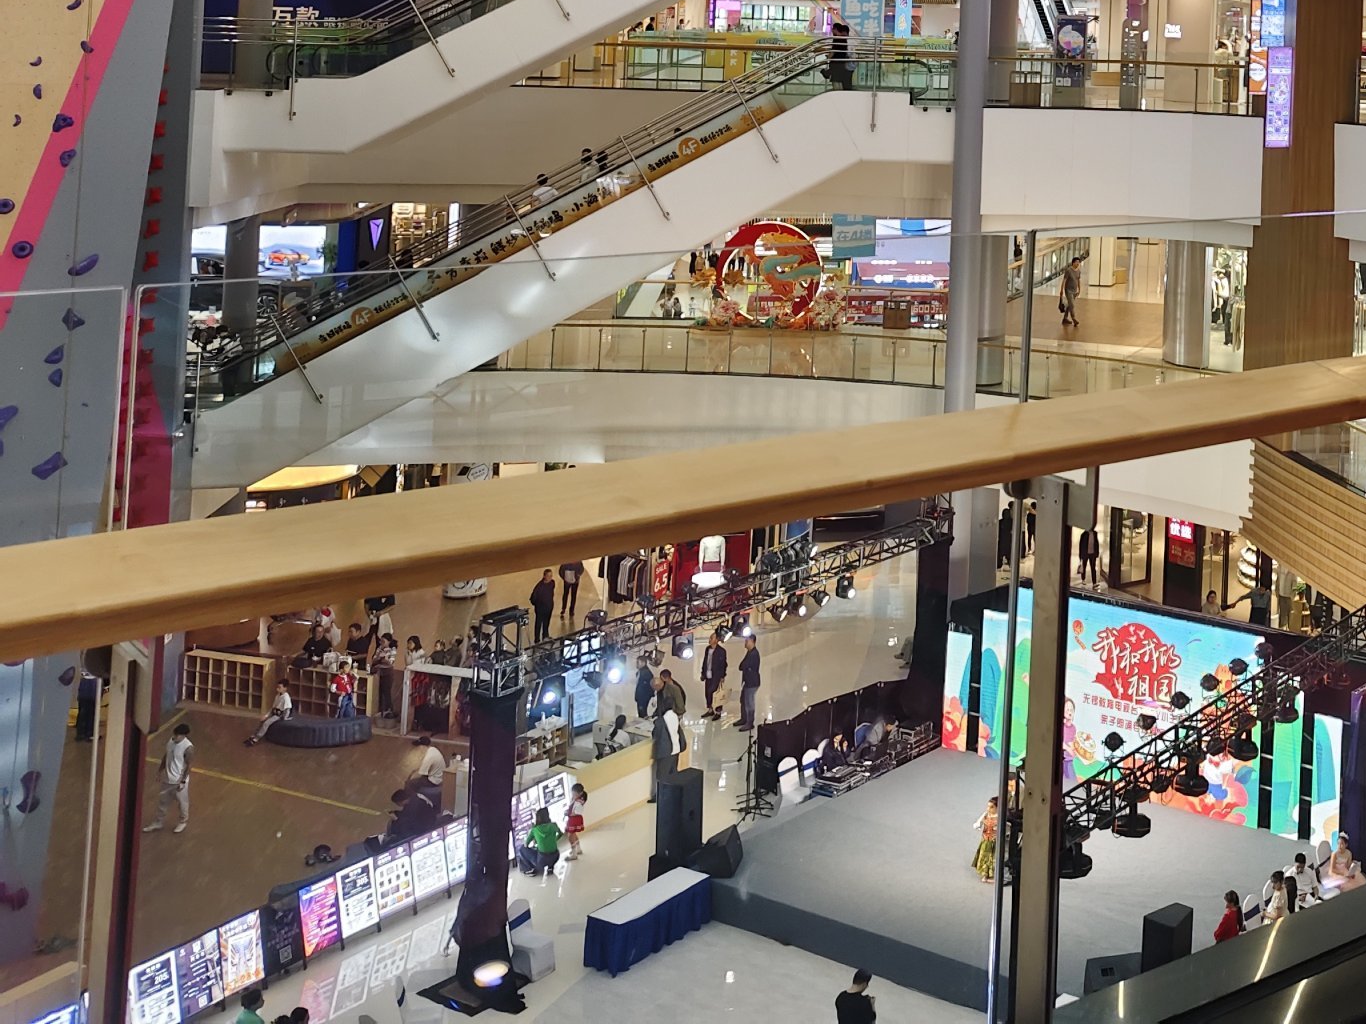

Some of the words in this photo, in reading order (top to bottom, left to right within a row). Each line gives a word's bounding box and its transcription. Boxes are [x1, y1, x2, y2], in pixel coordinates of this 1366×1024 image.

[682, 139, 697, 156] 4F
[355, 310, 372, 327] 4F
[656, 563, 667, 575] SALE
[654, 573, 668, 593] 6.5
[1092, 627, 1182, 674] 我和我的
[1127, 667, 1178, 708] 祖国
